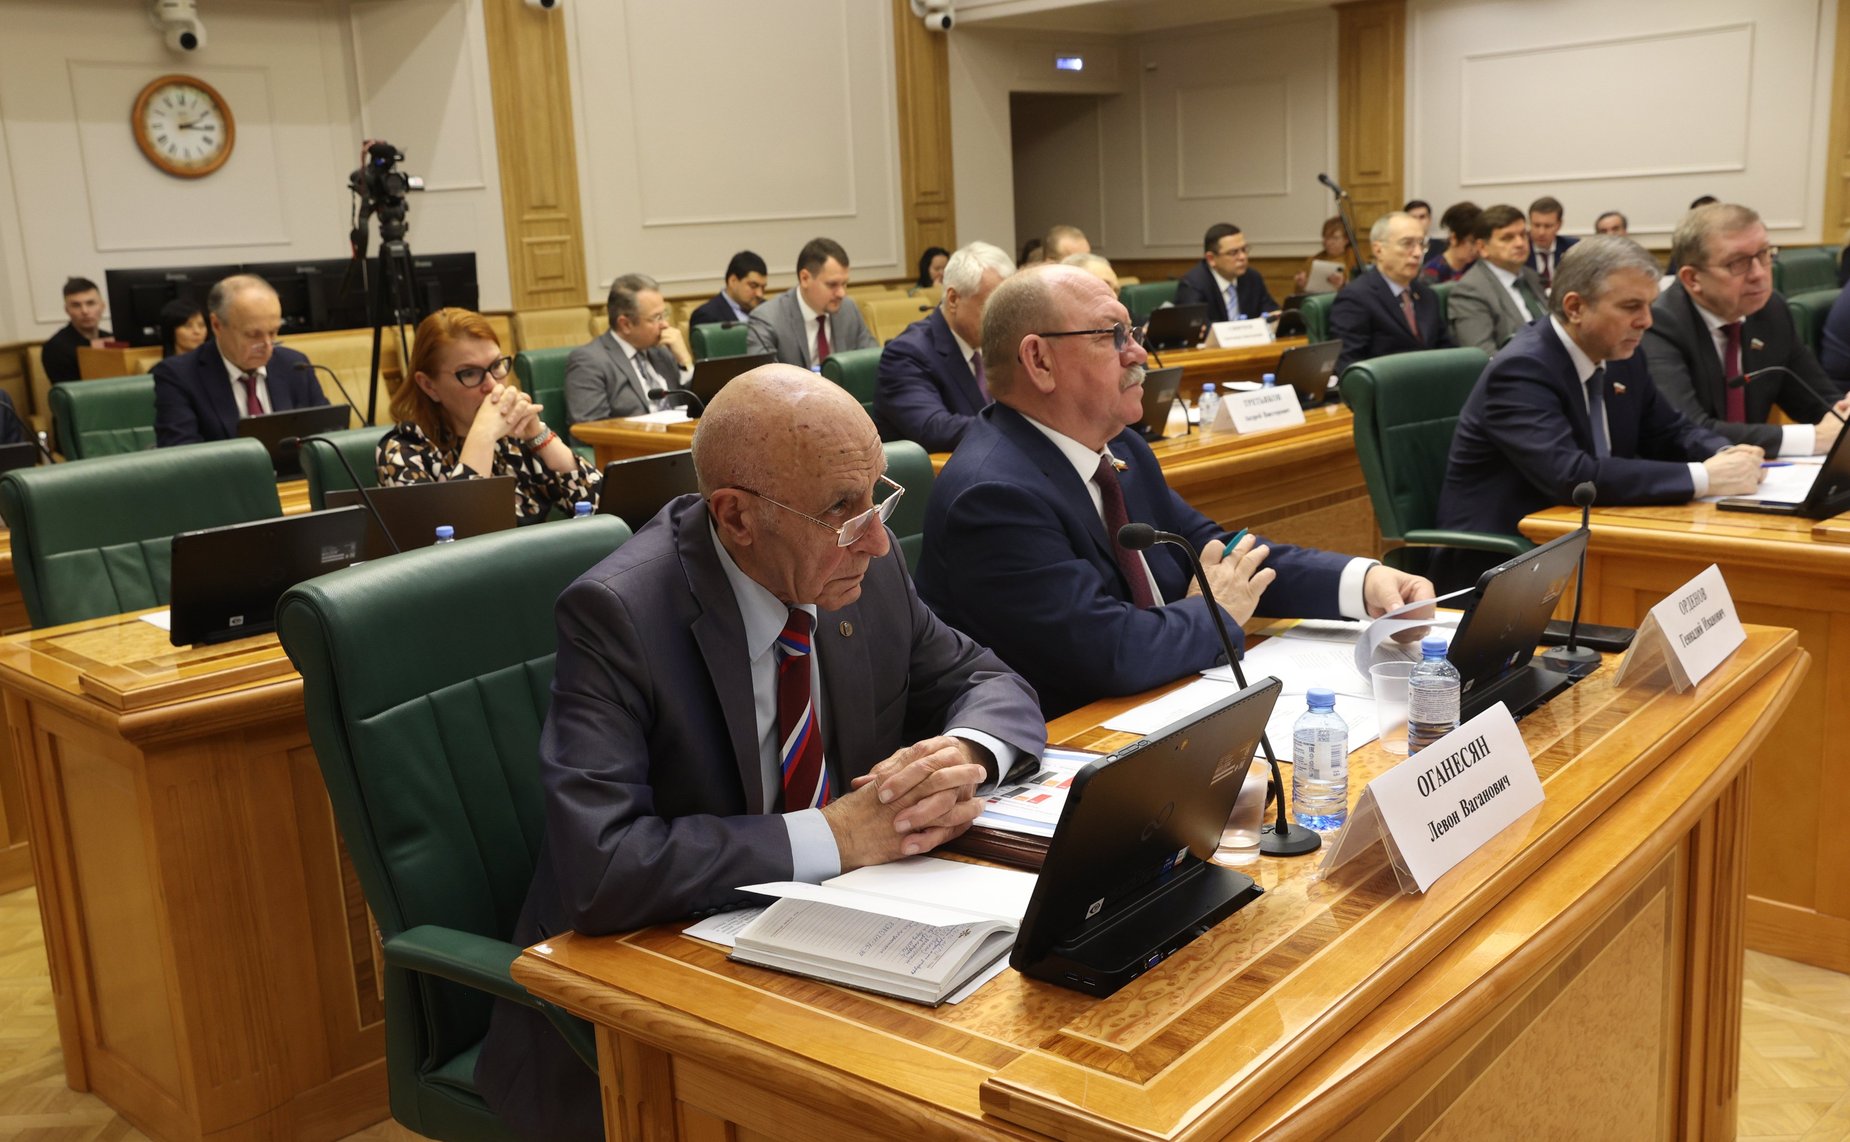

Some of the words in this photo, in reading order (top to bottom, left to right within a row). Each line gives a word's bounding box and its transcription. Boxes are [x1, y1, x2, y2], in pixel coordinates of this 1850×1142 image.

[1416, 734, 1492, 798] ОГАНЕСЯН
[1427, 809, 1461, 843] Левон
[1459, 774, 1512, 818] Ваганович
